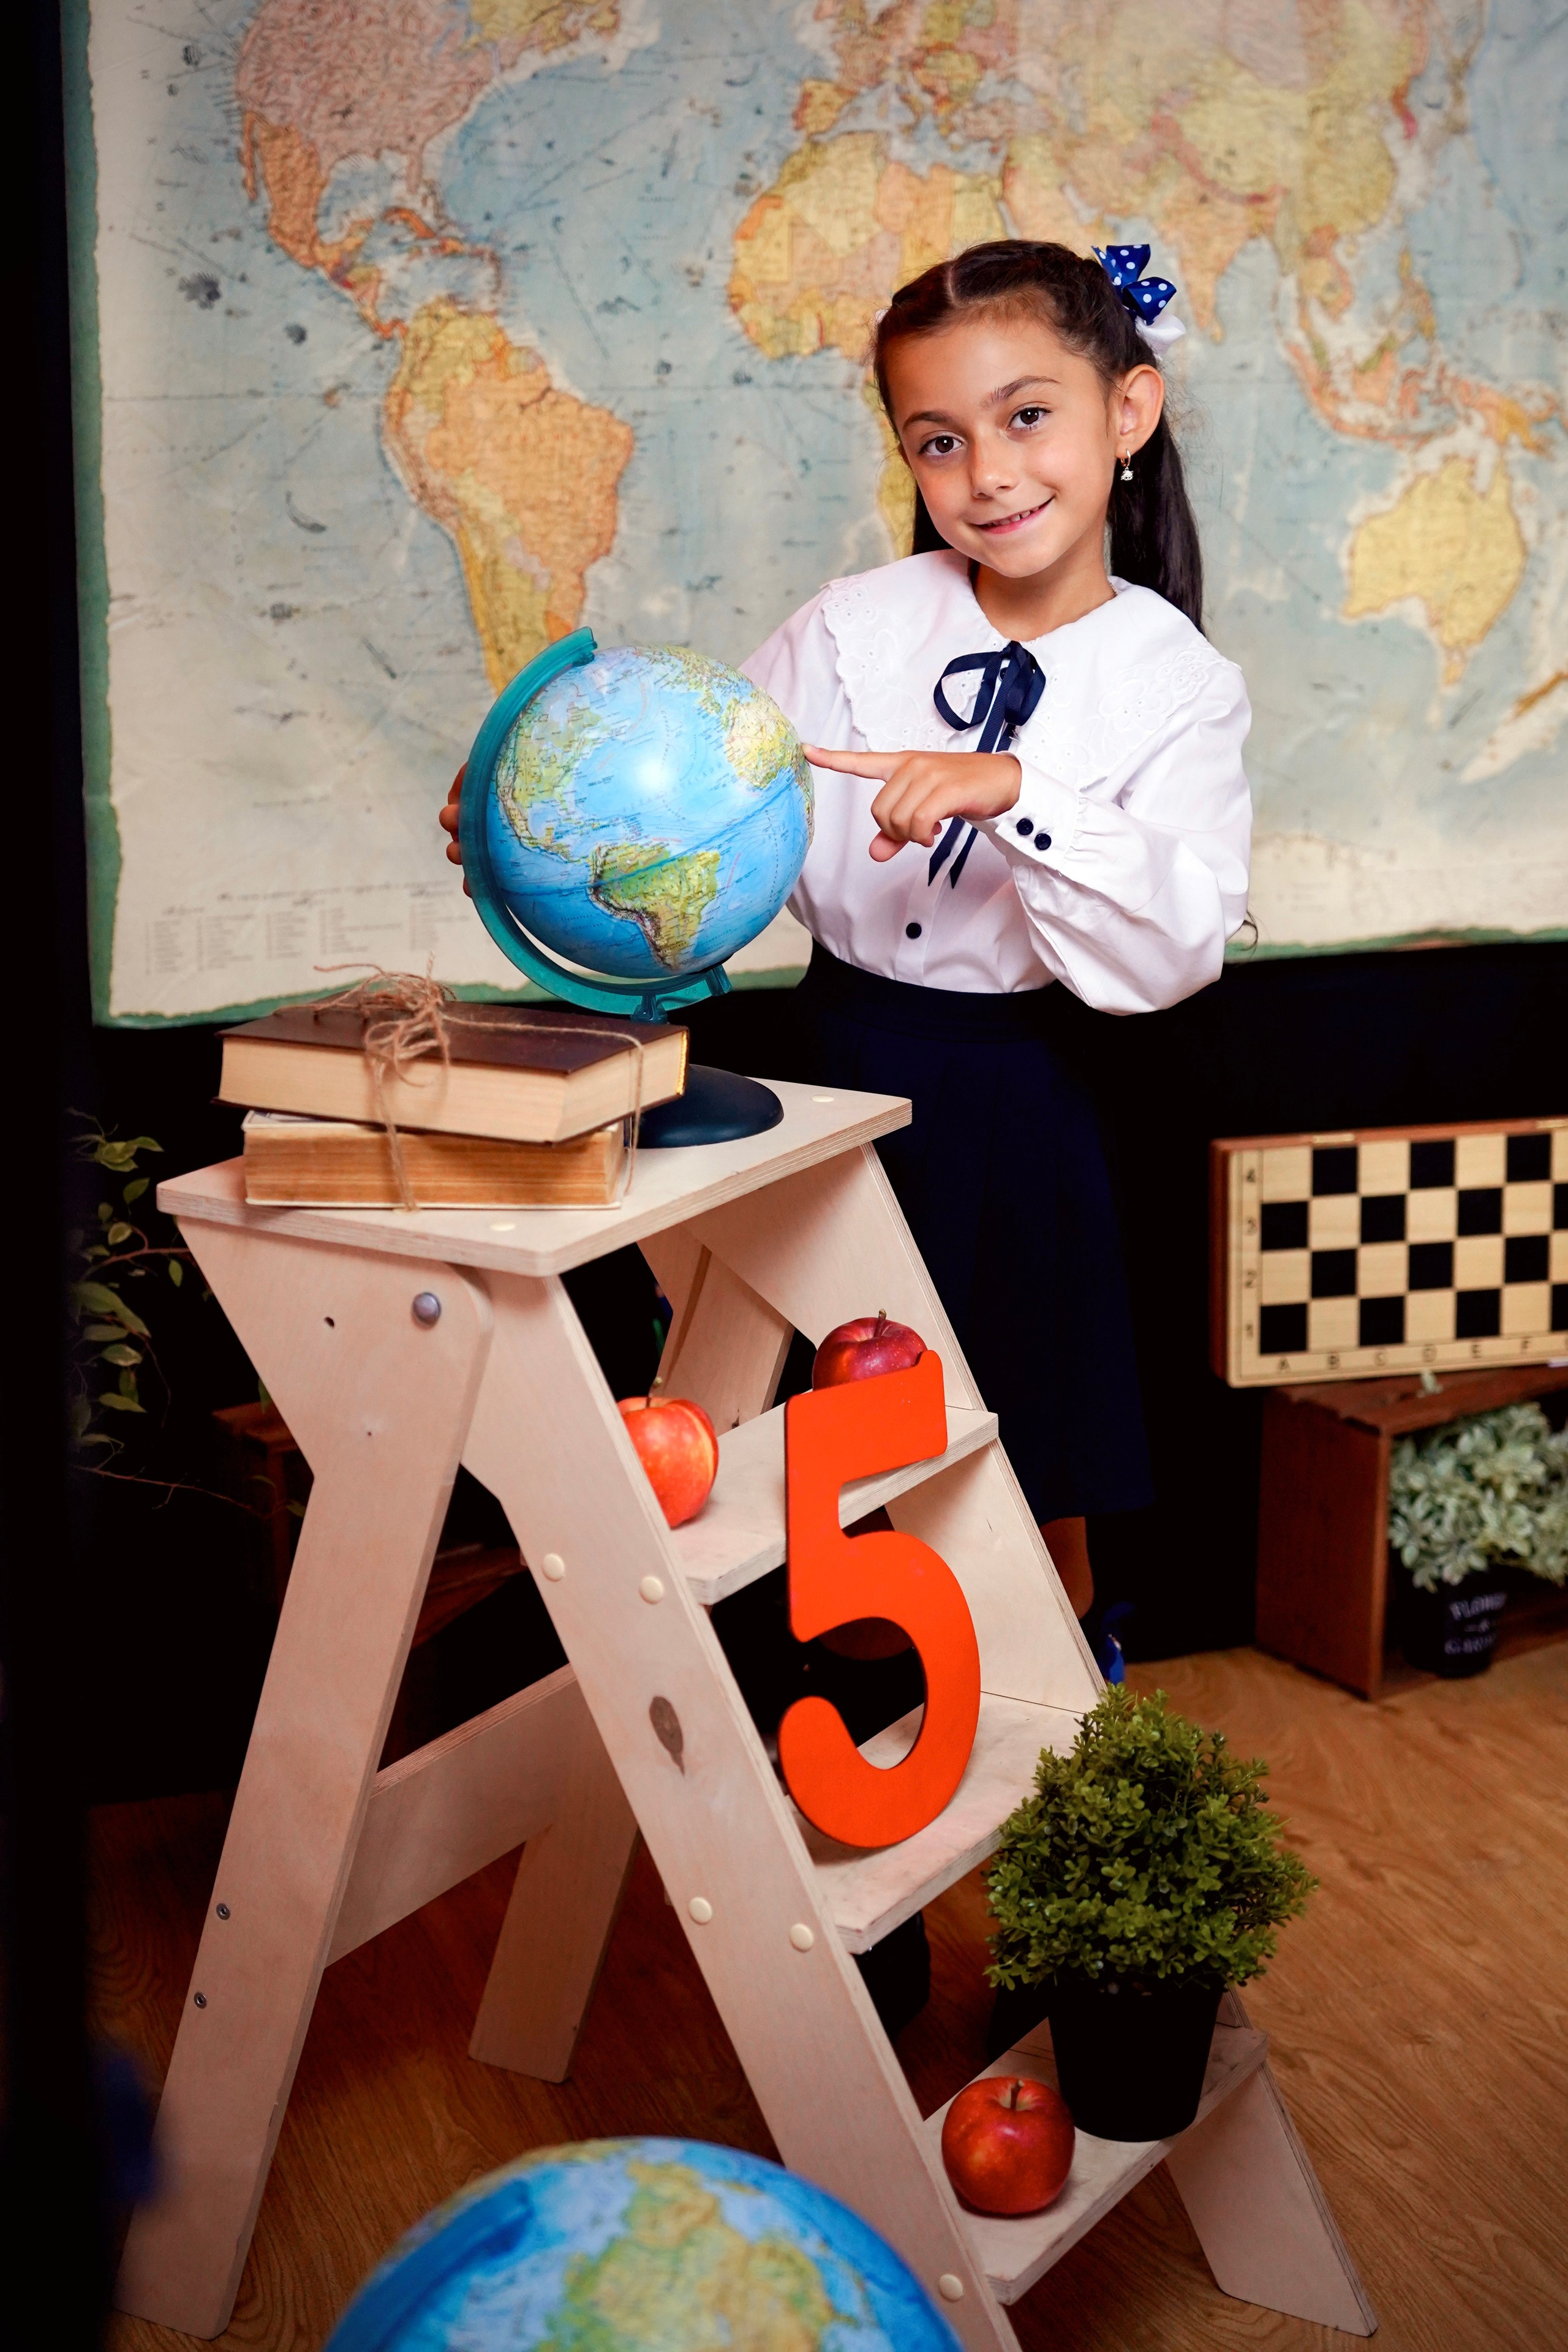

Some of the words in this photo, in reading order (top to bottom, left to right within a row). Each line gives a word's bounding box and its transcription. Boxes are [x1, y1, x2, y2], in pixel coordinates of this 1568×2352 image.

[1245, 1168, 1256, 1183] 4
[1245, 1218, 1257, 1235] 3
[1245, 1270, 1257, 1287] 2
[1245, 1324, 1254, 1338] 1
[1277, 1357, 1291, 1373] A
[1327, 1352, 1340, 1370] B
[1374, 1351, 1387, 1366] C
[1422, 1344, 1437, 1363] D
[1471, 1340, 1482, 1359] E
[1520, 1338, 1530, 1354] F
[778, 1349, 981, 1849] 5
